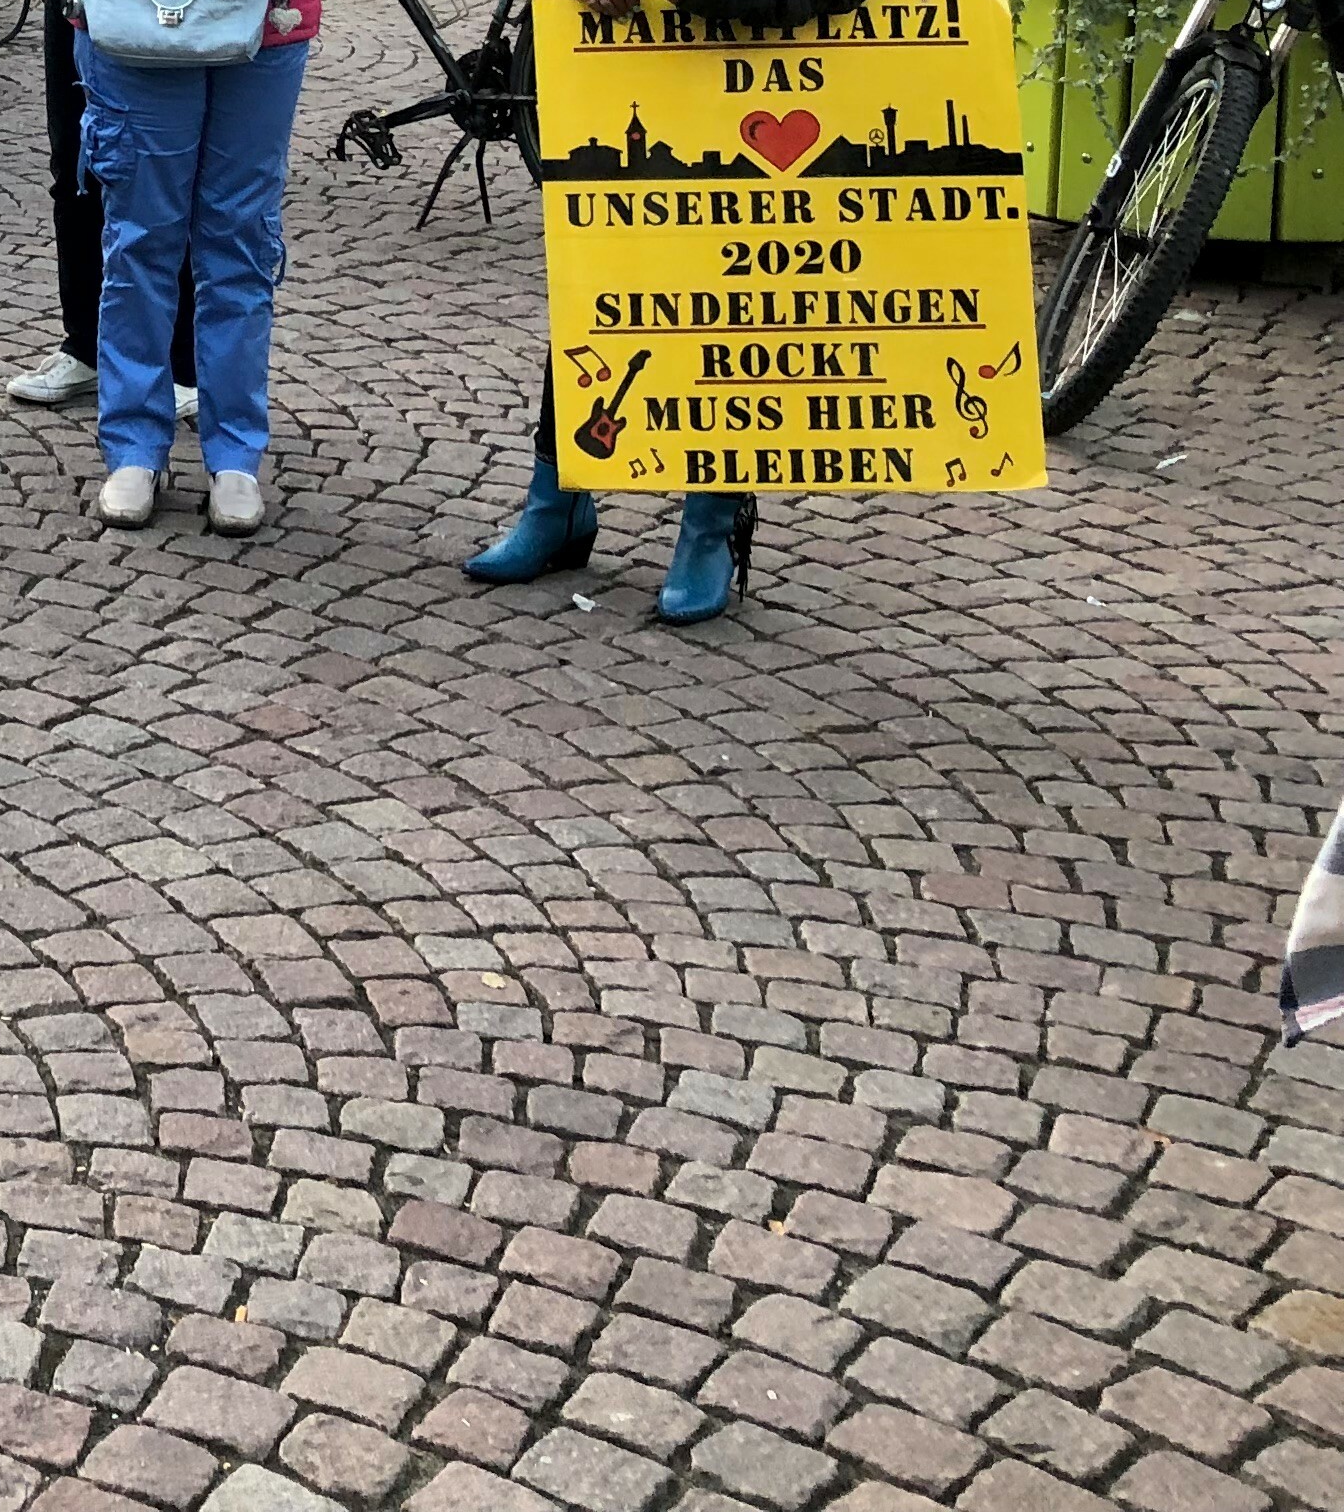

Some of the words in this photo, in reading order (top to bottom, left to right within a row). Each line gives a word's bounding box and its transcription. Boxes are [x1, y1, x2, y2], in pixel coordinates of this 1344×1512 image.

[724, 58, 825, 93] DAS
[567, 191, 816, 228] UNSERER
[839, 187, 1020, 221] STADT.
[721, 239, 862, 276] 2020
[595, 289, 980, 327] SINDELFINGEN
[700, 343, 880, 378] ROCKT
[644, 396, 783, 431] MUSS
[808, 394, 936, 430] HIER
[686, 448, 913, 484] BLEIBEN
